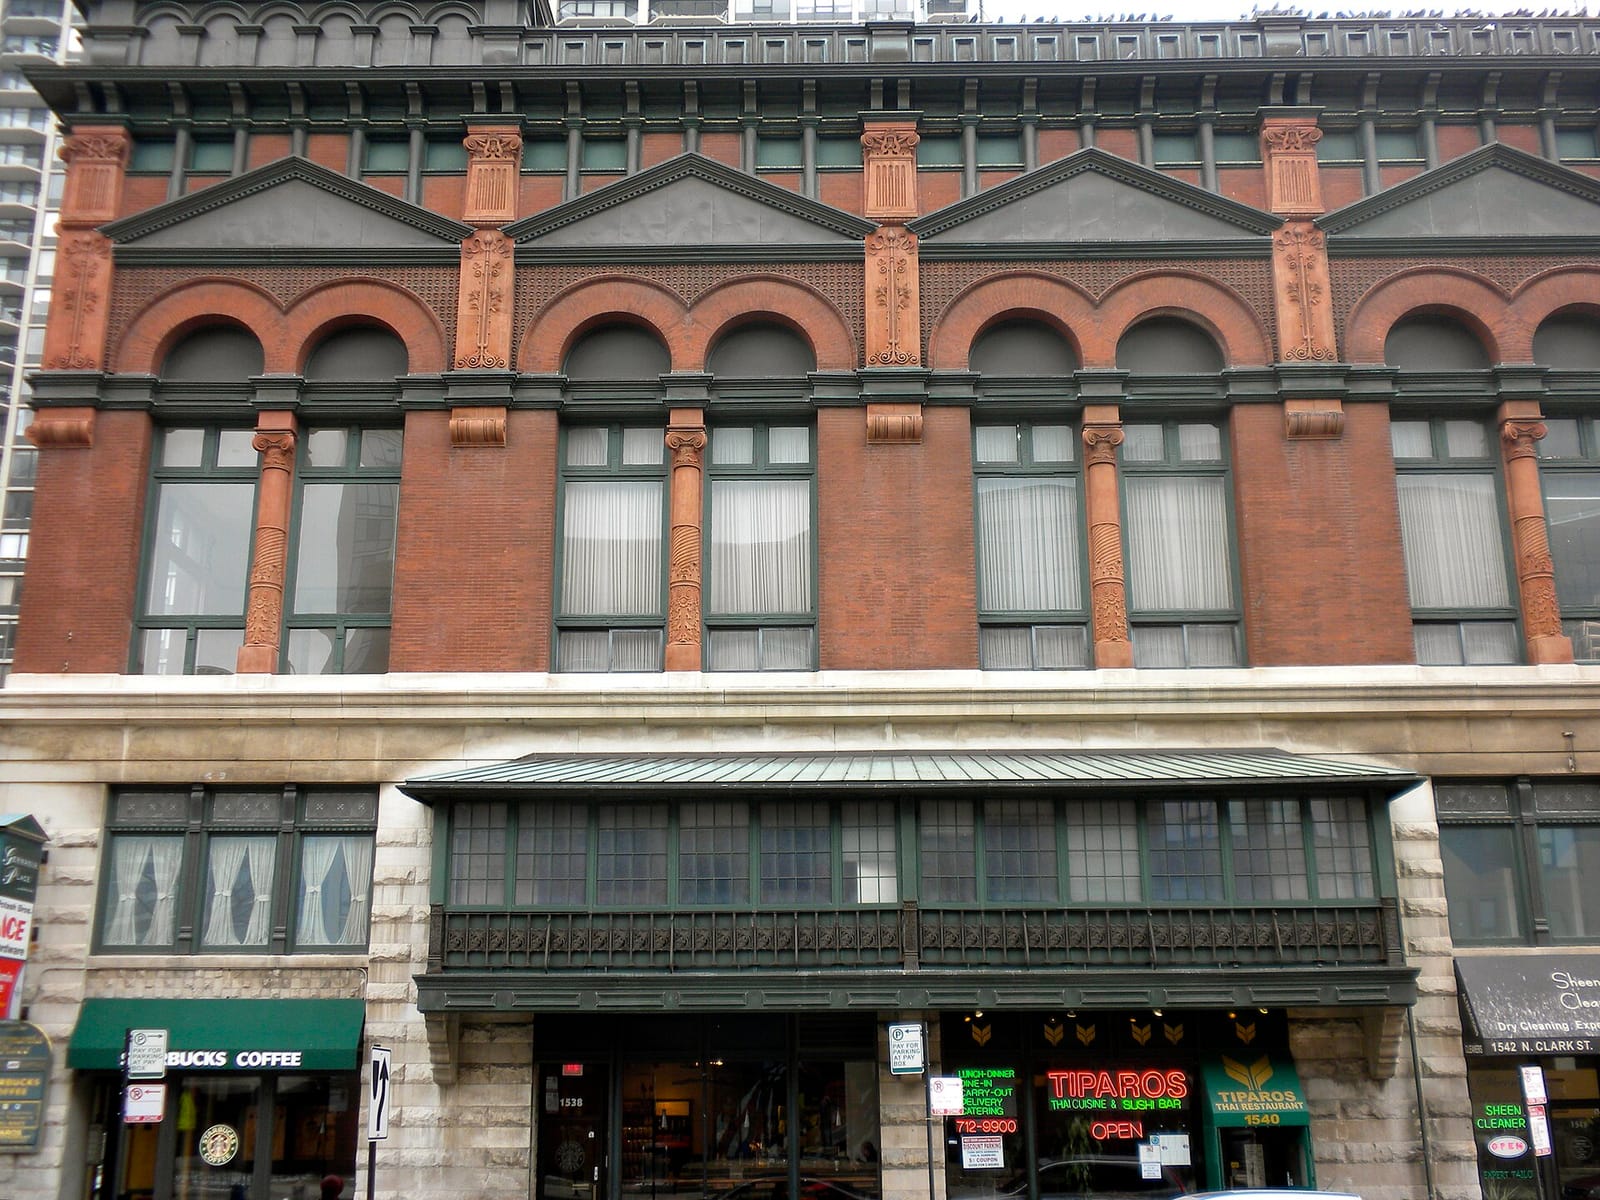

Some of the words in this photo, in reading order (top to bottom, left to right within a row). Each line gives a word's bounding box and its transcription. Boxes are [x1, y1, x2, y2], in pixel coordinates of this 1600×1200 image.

[1498, 1022, 1517, 1033] Dry
[1491, 1041, 1518, 1053] 1542
[1521, 1041, 1534, 1052] N.
[1535, 1041, 1575, 1052] CLARK
[1576, 1040, 1594, 1051] ST.
[235, 1051, 302, 1067] COFFEE
[958, 1069, 1015, 1079] LUNCH-DINNER
[1047, 1070, 1188, 1099] TIPAROS
[560, 1098, 583, 1107] 1538
[1217, 1090, 1297, 1103] TIPAROS
[1050, 1099, 1071, 1110] THAI
[1072, 1099, 1107, 1110] CUISINE
[1110, 1099, 1117, 1109] &
[1123, 1100, 1155, 1110] SUSHI
[1158, 1098, 1182, 1110] BAR
[1215, 1102, 1239, 1111] THAI
[1241, 1101, 1304, 1111] RESTAURANT
[1485, 1105, 1521, 1116] SHEEN
[1244, 1113, 1280, 1125] 1540
[1476, 1118, 1526, 1129] CLEANER
[956, 1120, 1017, 1133] 712-9900
[1092, 1122, 1144, 1140] OPEN
[1491, 1142, 1524, 1151] OPEN
